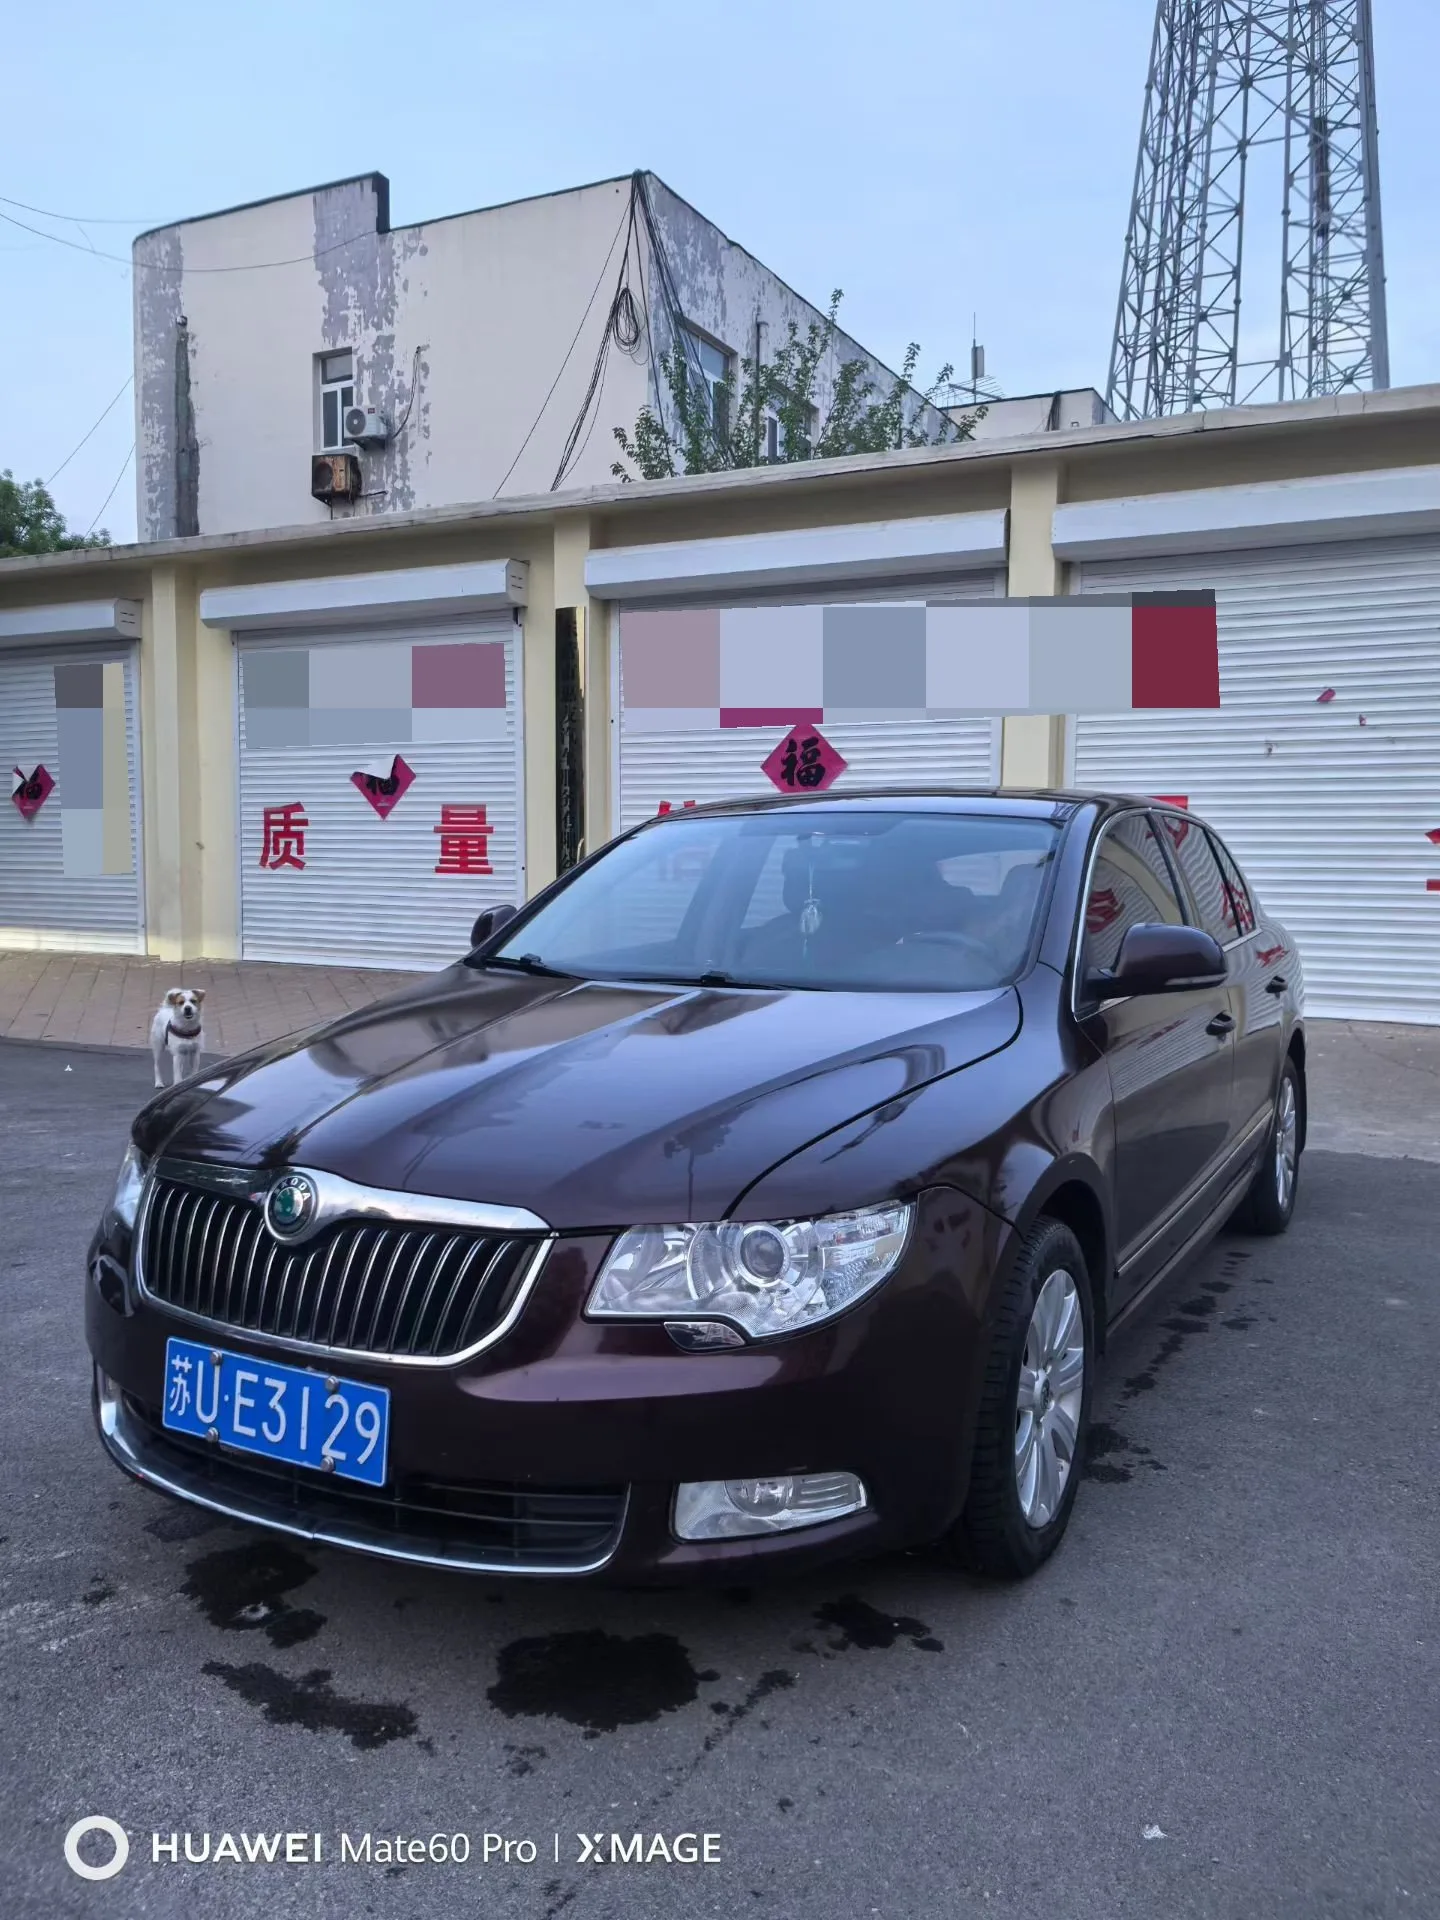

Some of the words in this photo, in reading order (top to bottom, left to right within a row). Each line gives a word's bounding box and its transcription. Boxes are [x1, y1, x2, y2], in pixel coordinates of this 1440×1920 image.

[781, 737, 826, 787] 福
[259, 802, 309, 870] 质
[434, 804, 494, 874] 量
